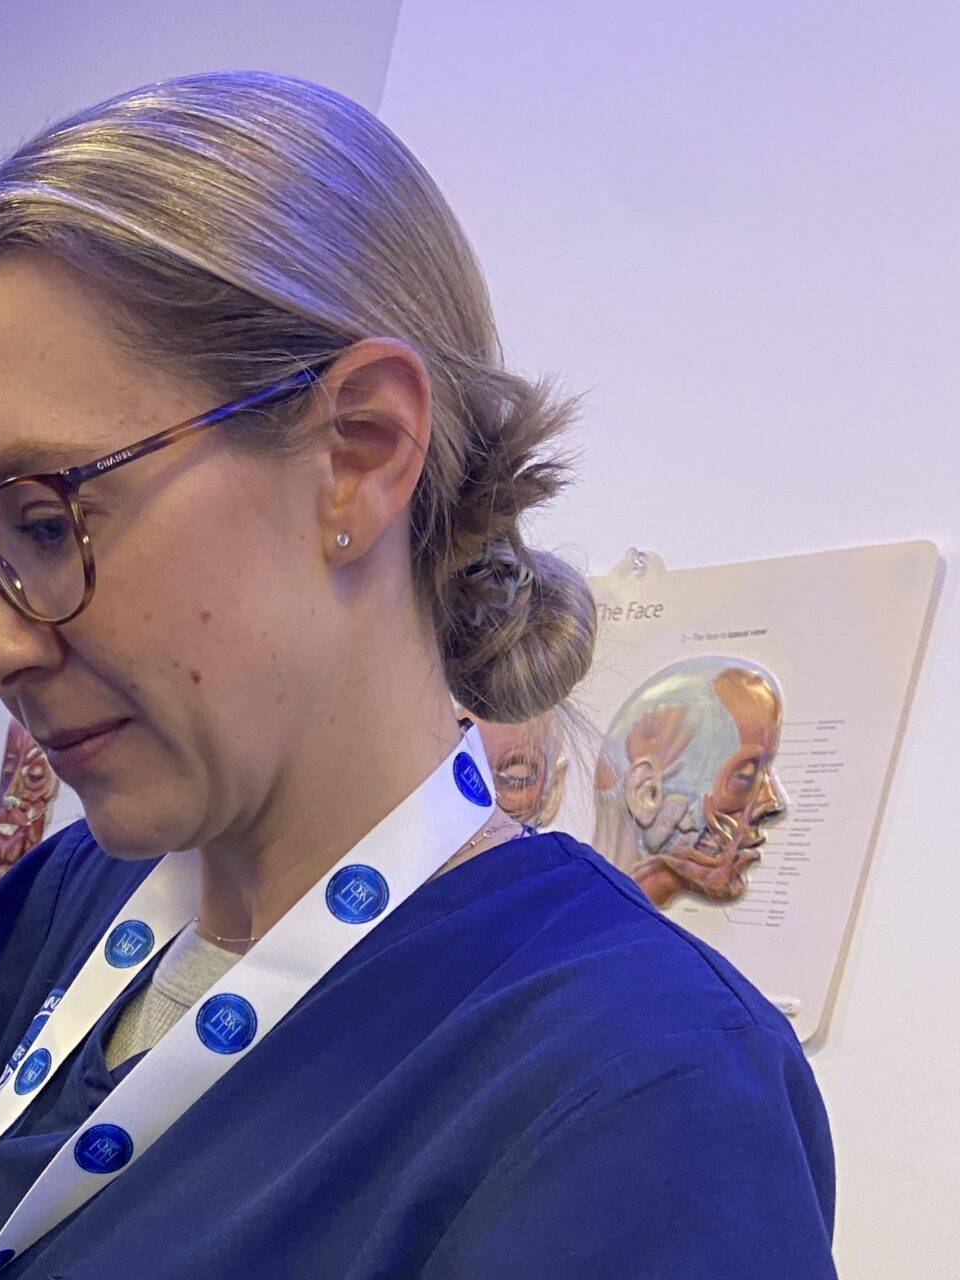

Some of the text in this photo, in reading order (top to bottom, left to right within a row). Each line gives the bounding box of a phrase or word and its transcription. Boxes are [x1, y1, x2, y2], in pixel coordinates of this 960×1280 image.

[96, 449, 134, 470] CHANEL
[596, 600, 665, 622] The Face
